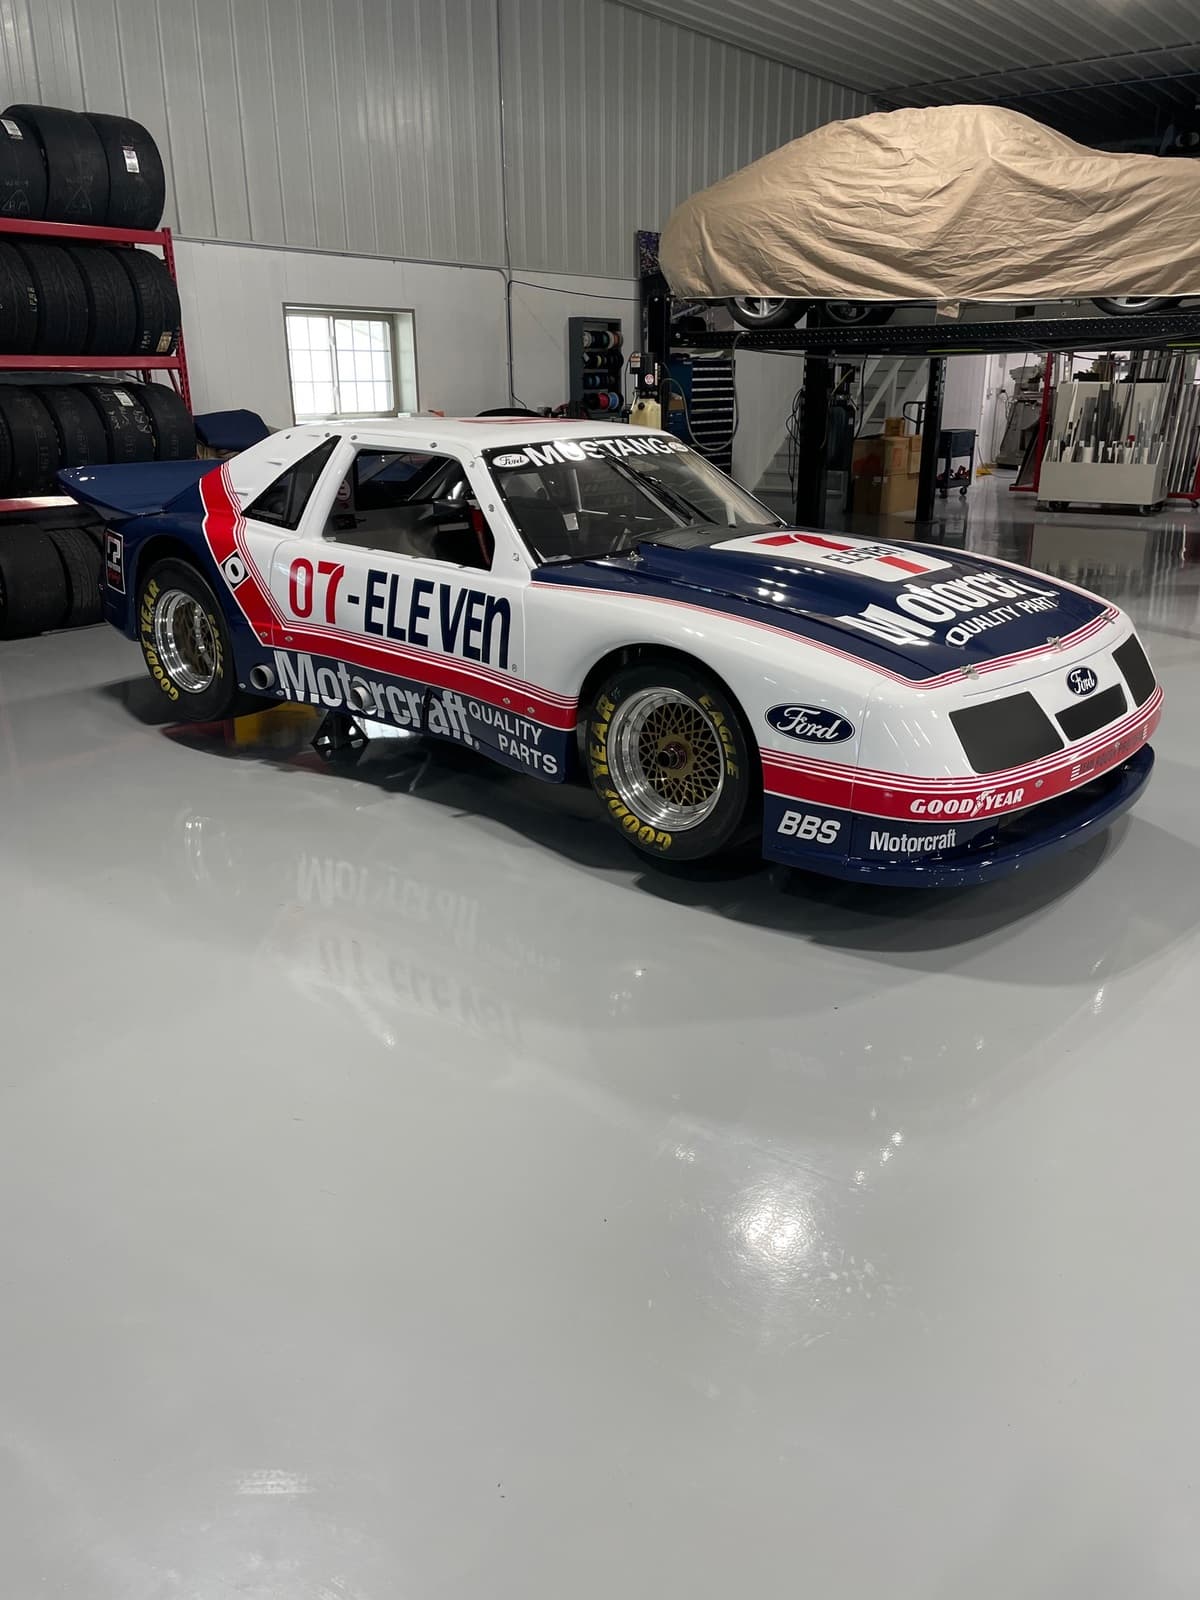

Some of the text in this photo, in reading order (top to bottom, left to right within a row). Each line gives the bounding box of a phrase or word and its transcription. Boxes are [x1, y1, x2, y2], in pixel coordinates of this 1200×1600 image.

[522, 437, 673, 467] MUSTANG
[944, 597, 1057, 648] QUALITY PART
[468, 701, 543, 746] QUALITY
[699, 695, 740, 780] EAGLE
[498, 733, 559, 775] PARTS
[776, 810, 842, 845] BBS
[869, 827, 957, 854] Motorcraft
